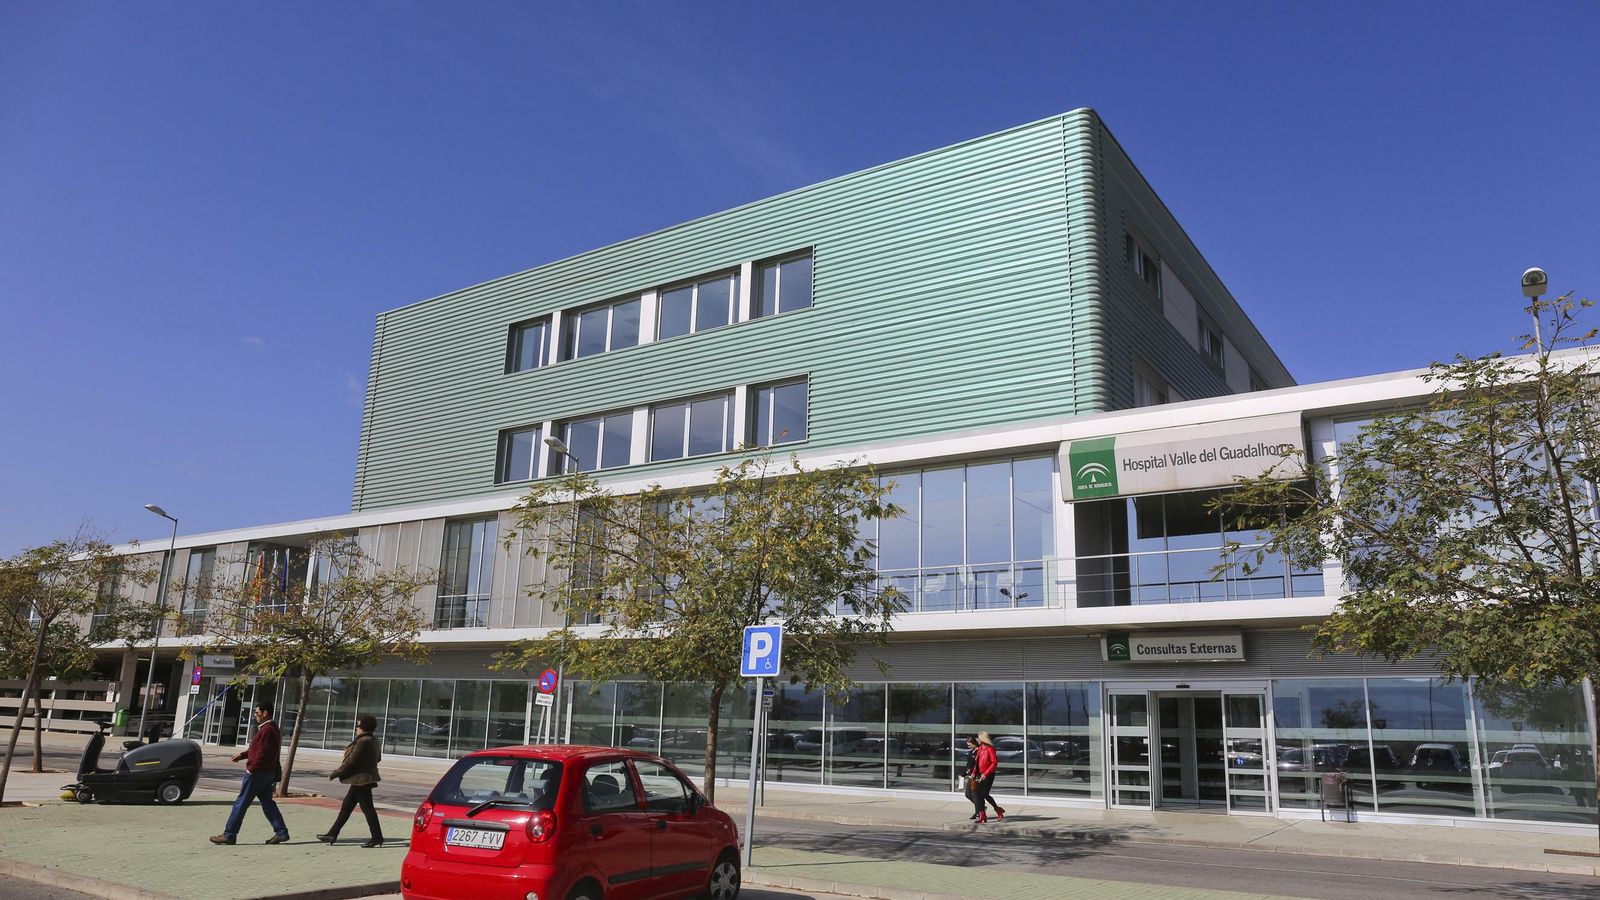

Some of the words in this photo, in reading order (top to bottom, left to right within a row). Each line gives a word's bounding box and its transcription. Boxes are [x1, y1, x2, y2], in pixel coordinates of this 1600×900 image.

[1122, 453, 1168, 473] Hospital
[1168, 450, 1197, 466] Valle
[1199, 447, 1217, 463] del
[748, 632, 773, 670] P
[1136, 643, 1188, 655] Consultas
[1189, 642, 1238, 654] Externas
[452, 829, 478, 842] 2267
[482, 832, 503, 845] FVV
